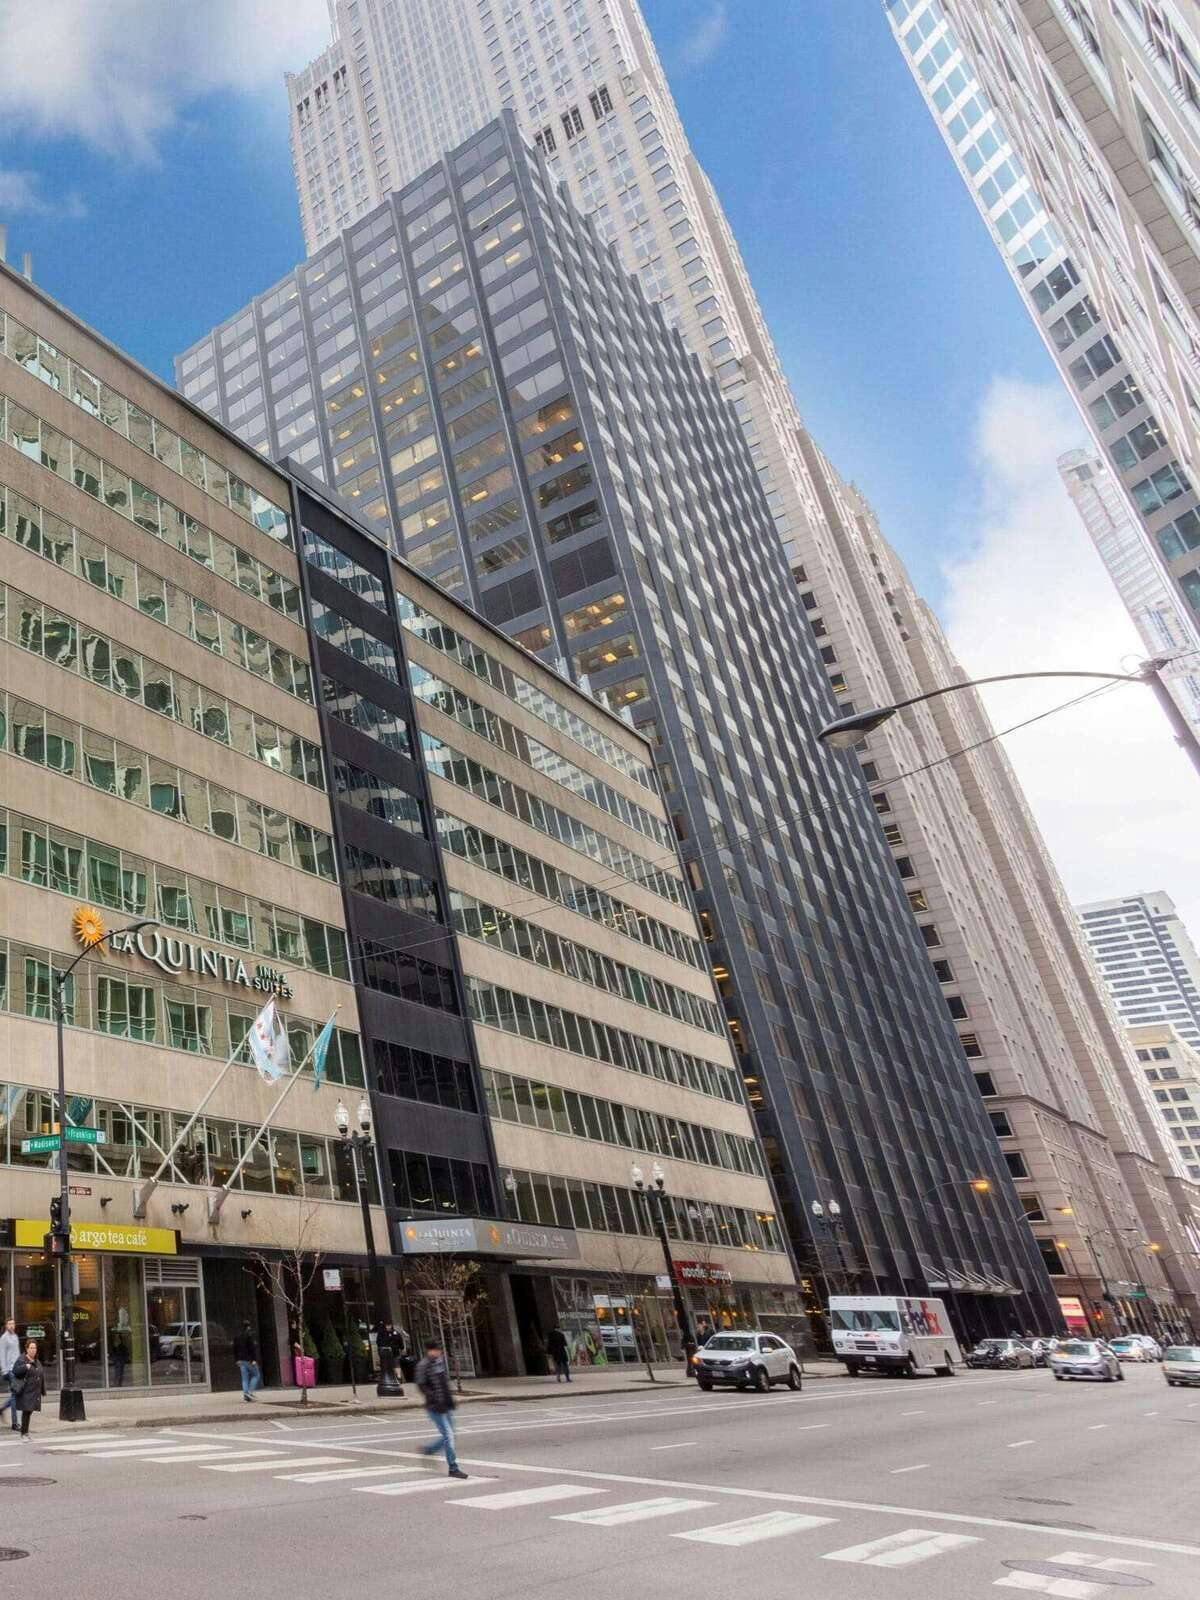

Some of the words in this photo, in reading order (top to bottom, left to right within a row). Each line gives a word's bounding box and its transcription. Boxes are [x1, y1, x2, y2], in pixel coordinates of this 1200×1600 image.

[111, 929, 135, 954] LA
[137, 925, 252, 987] QUINTA
[257, 965, 277, 981] INN
[255, 977, 296, 999] SUITES
[70, 1128, 92, 1139] Franklin
[34, 1140, 54, 1149] Madison
[79, 1230, 107, 1247] argo
[108, 1230, 124, 1244] tea
[127, 1230, 147, 1246] café
